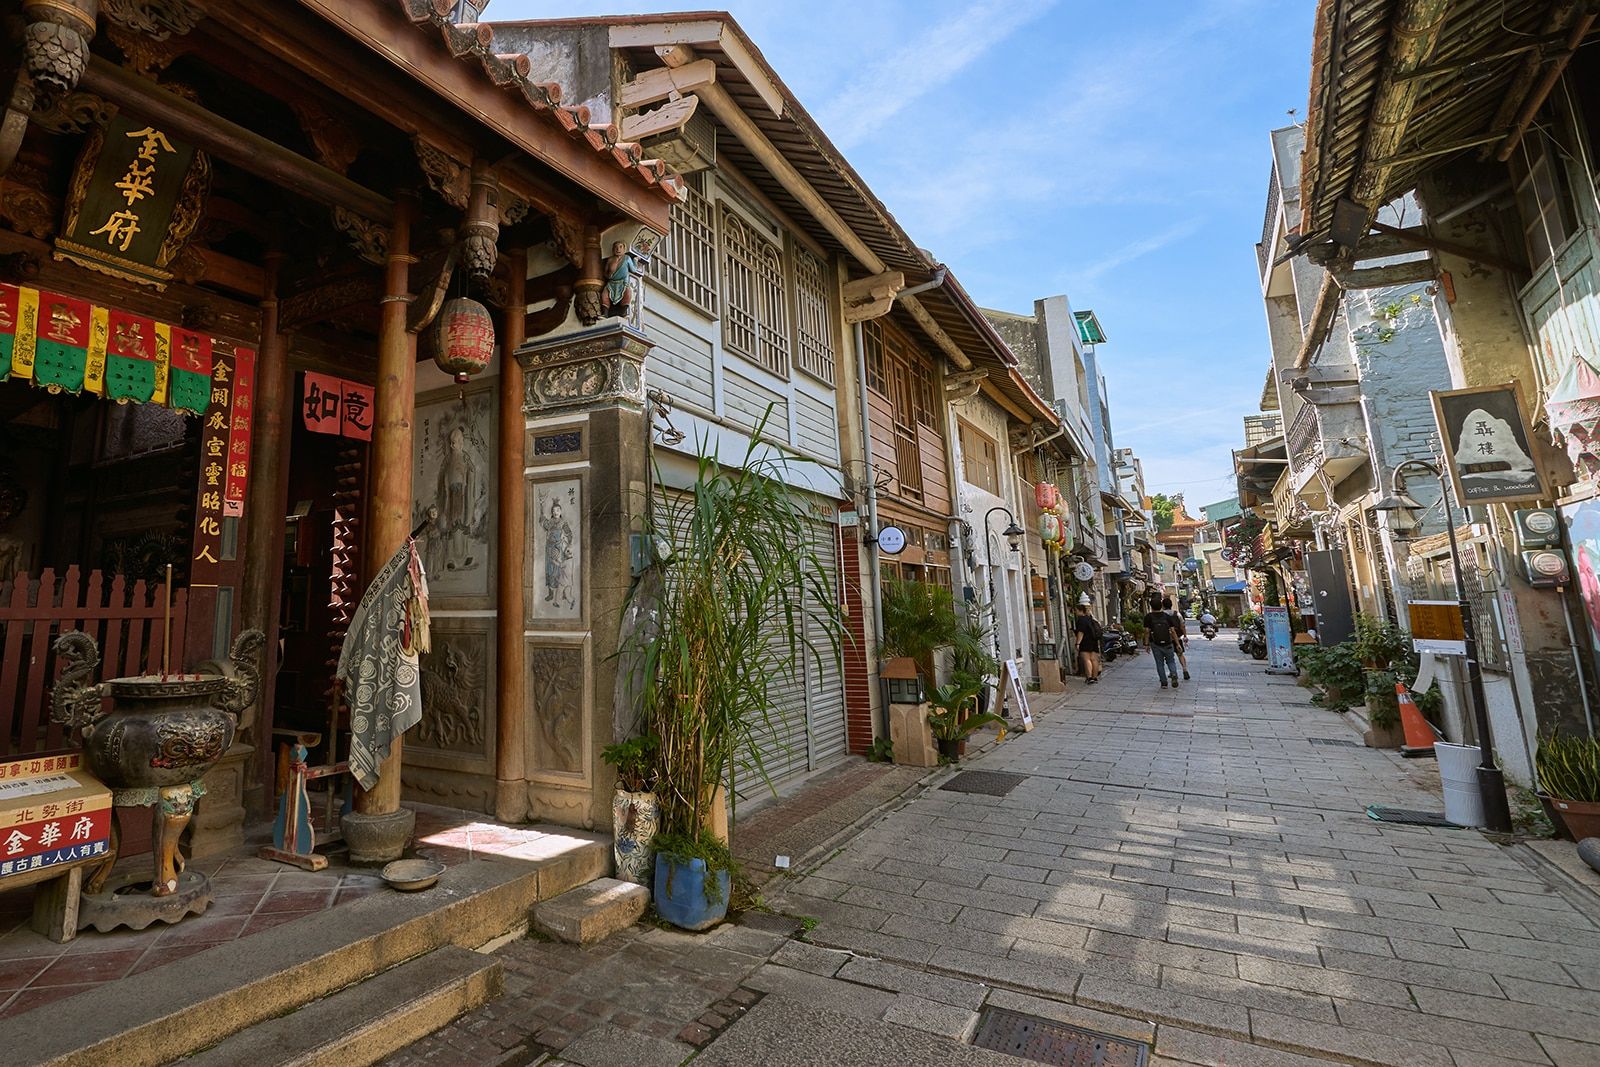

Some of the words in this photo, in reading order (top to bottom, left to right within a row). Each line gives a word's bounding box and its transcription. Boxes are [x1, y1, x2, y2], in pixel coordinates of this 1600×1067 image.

[89, 126, 177, 252] 金華府
[304, 381, 372, 431] 如意
[15, 799, 85, 824] 北勢街
[3, 816, 94, 855] 金華府
